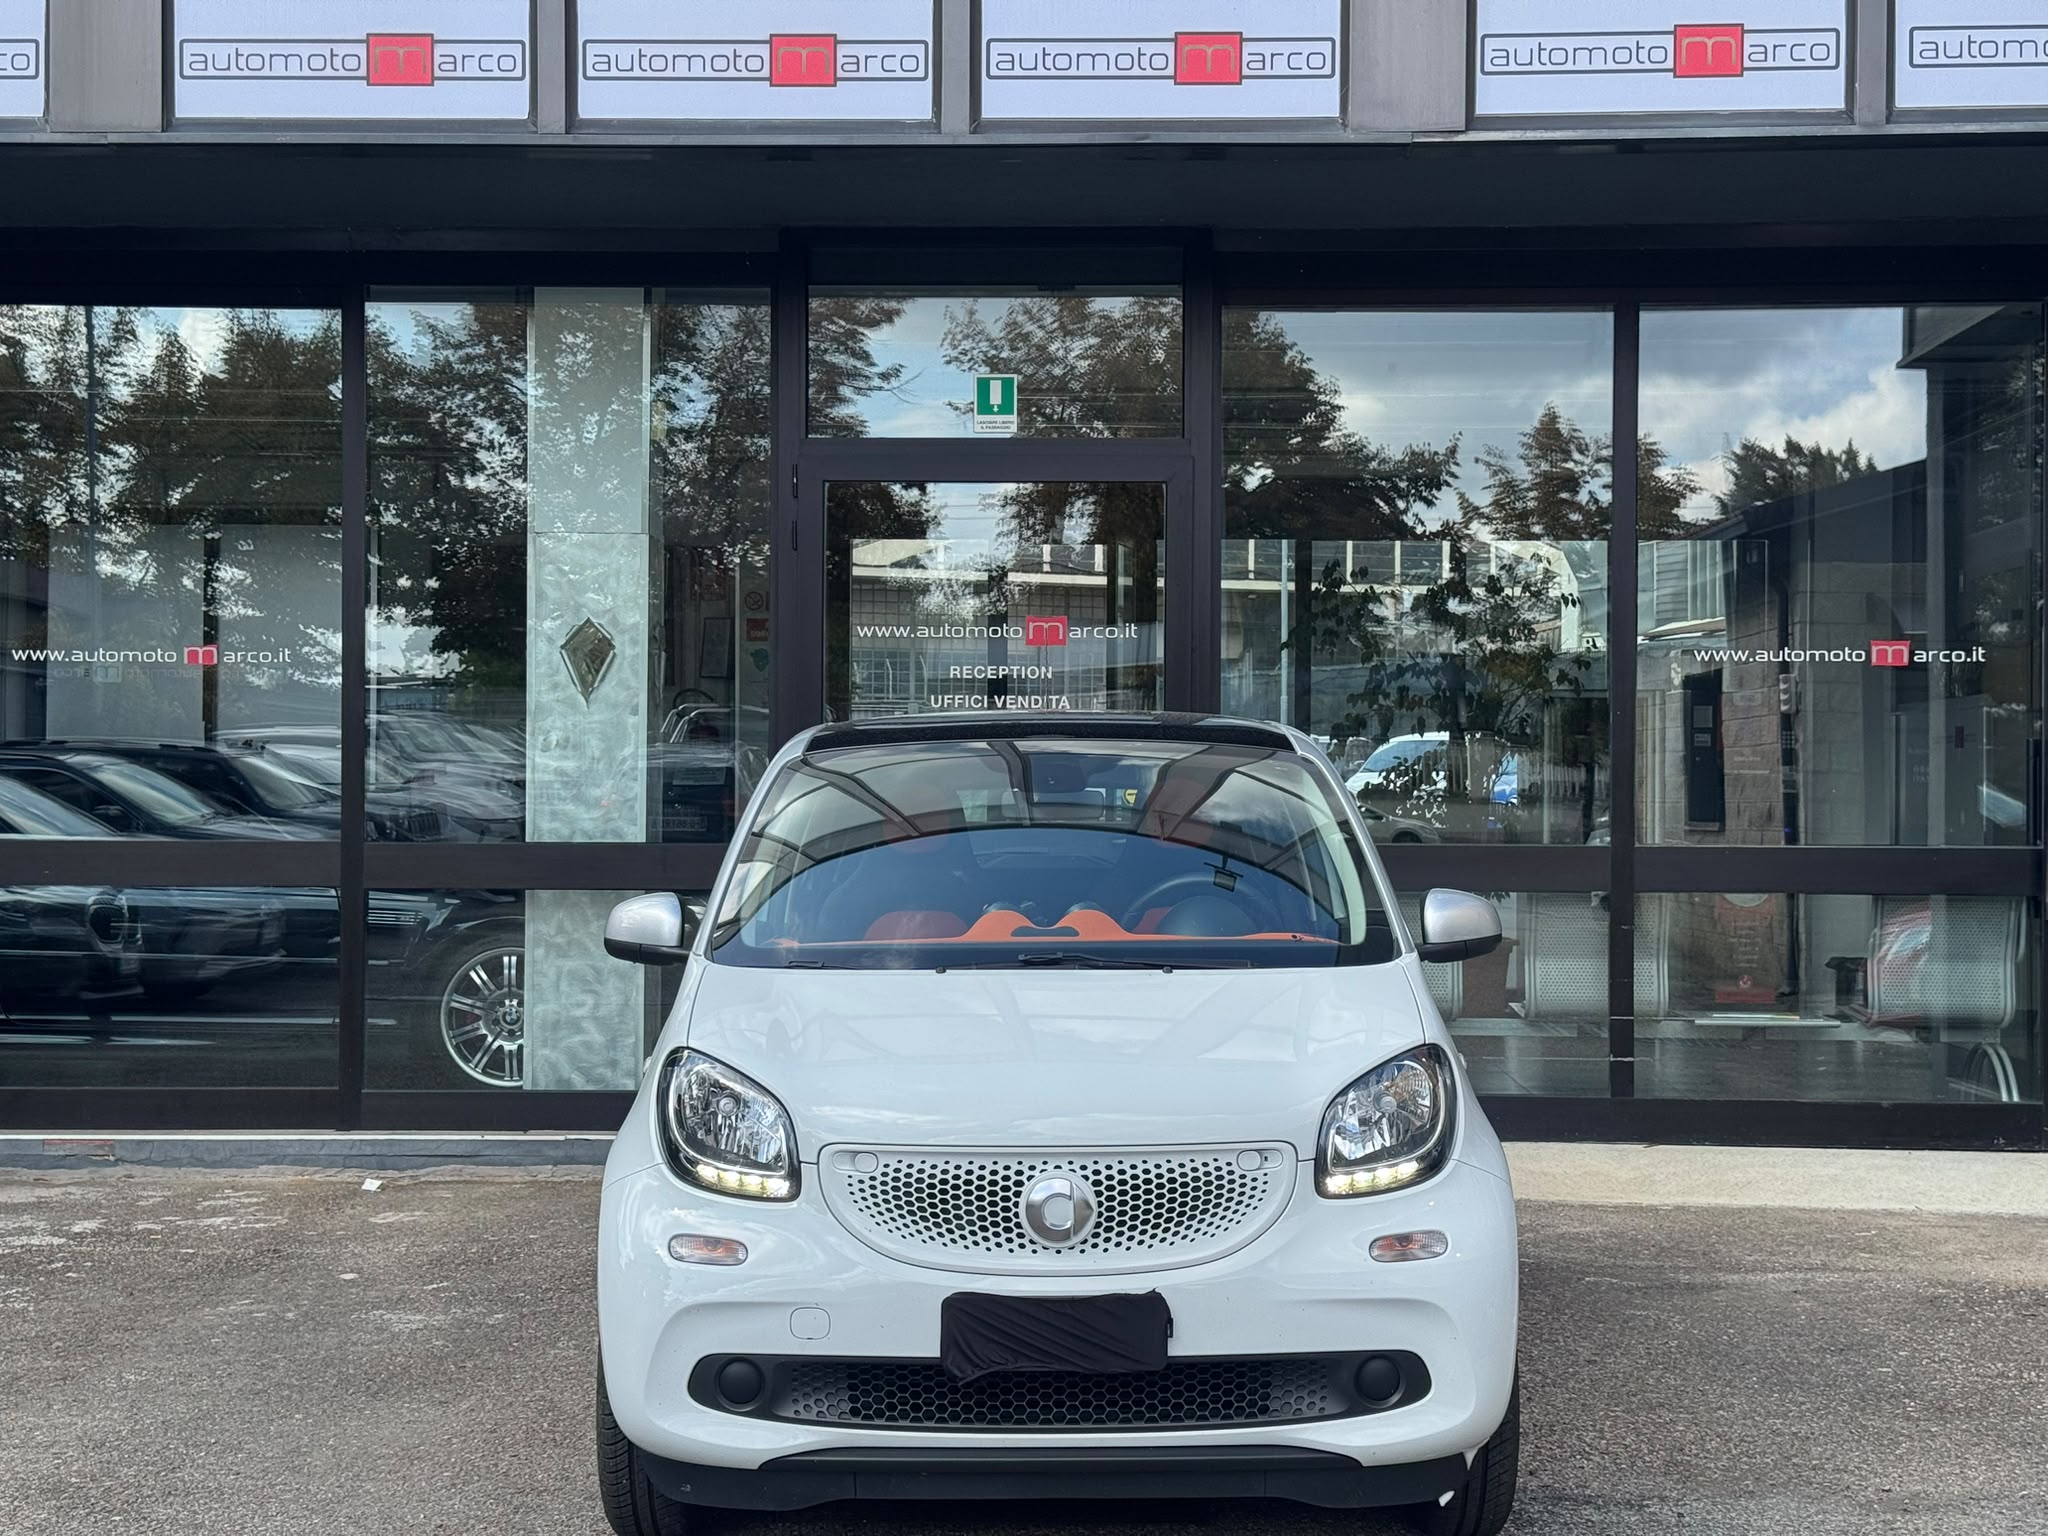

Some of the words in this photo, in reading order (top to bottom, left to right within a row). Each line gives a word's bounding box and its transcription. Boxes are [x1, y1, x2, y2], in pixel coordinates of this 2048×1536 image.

[1919, 34, 2048, 59] autom
[950, 666, 1053, 679] RECEPTION
[930, 695, 988, 709] UFFICI
